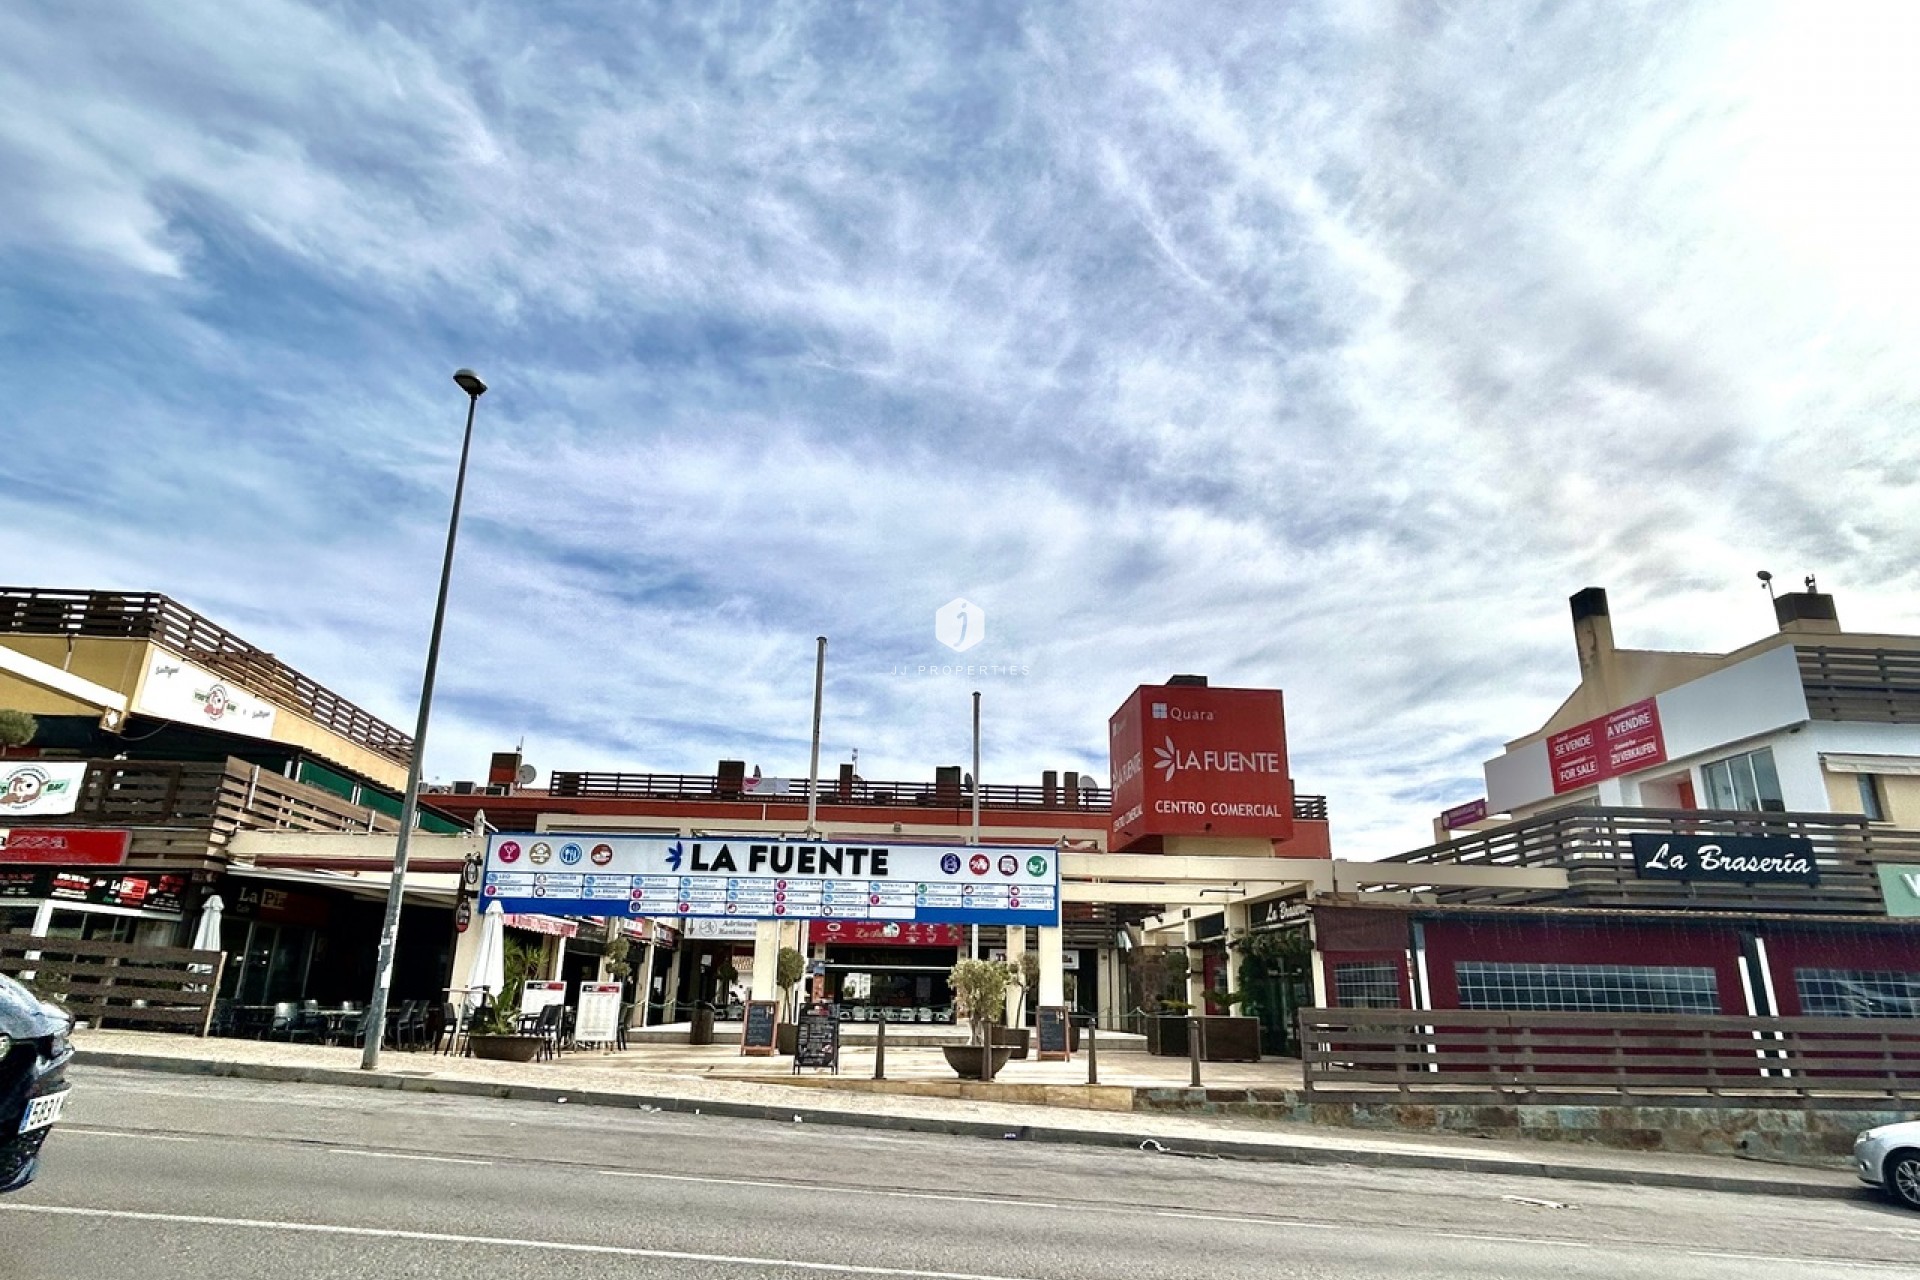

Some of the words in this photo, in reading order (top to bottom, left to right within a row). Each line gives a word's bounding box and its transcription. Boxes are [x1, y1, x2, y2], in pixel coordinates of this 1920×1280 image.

[1170, 706, 1215, 722] Quara
[1607, 725, 1615, 738] A
[1613, 712, 1651, 734] VENDRE
[1554, 743, 1566, 756] SE
[1565, 734, 1592, 753] VENDE
[1175, 750, 1202, 770] LA
[1203, 751, 1280, 774] FUENTE
[1560, 768, 1576, 781] FOR
[1575, 761, 1597, 776] SALE
[1154, 800, 1206, 815] CENTRO
[1210, 802, 1282, 818] COMERCIAL
[690, 843, 737, 872] LA
[749, 845, 889, 876] FUENTE
[1645, 843, 1689, 871] La
[1698, 844, 1811, 875] Brasería
